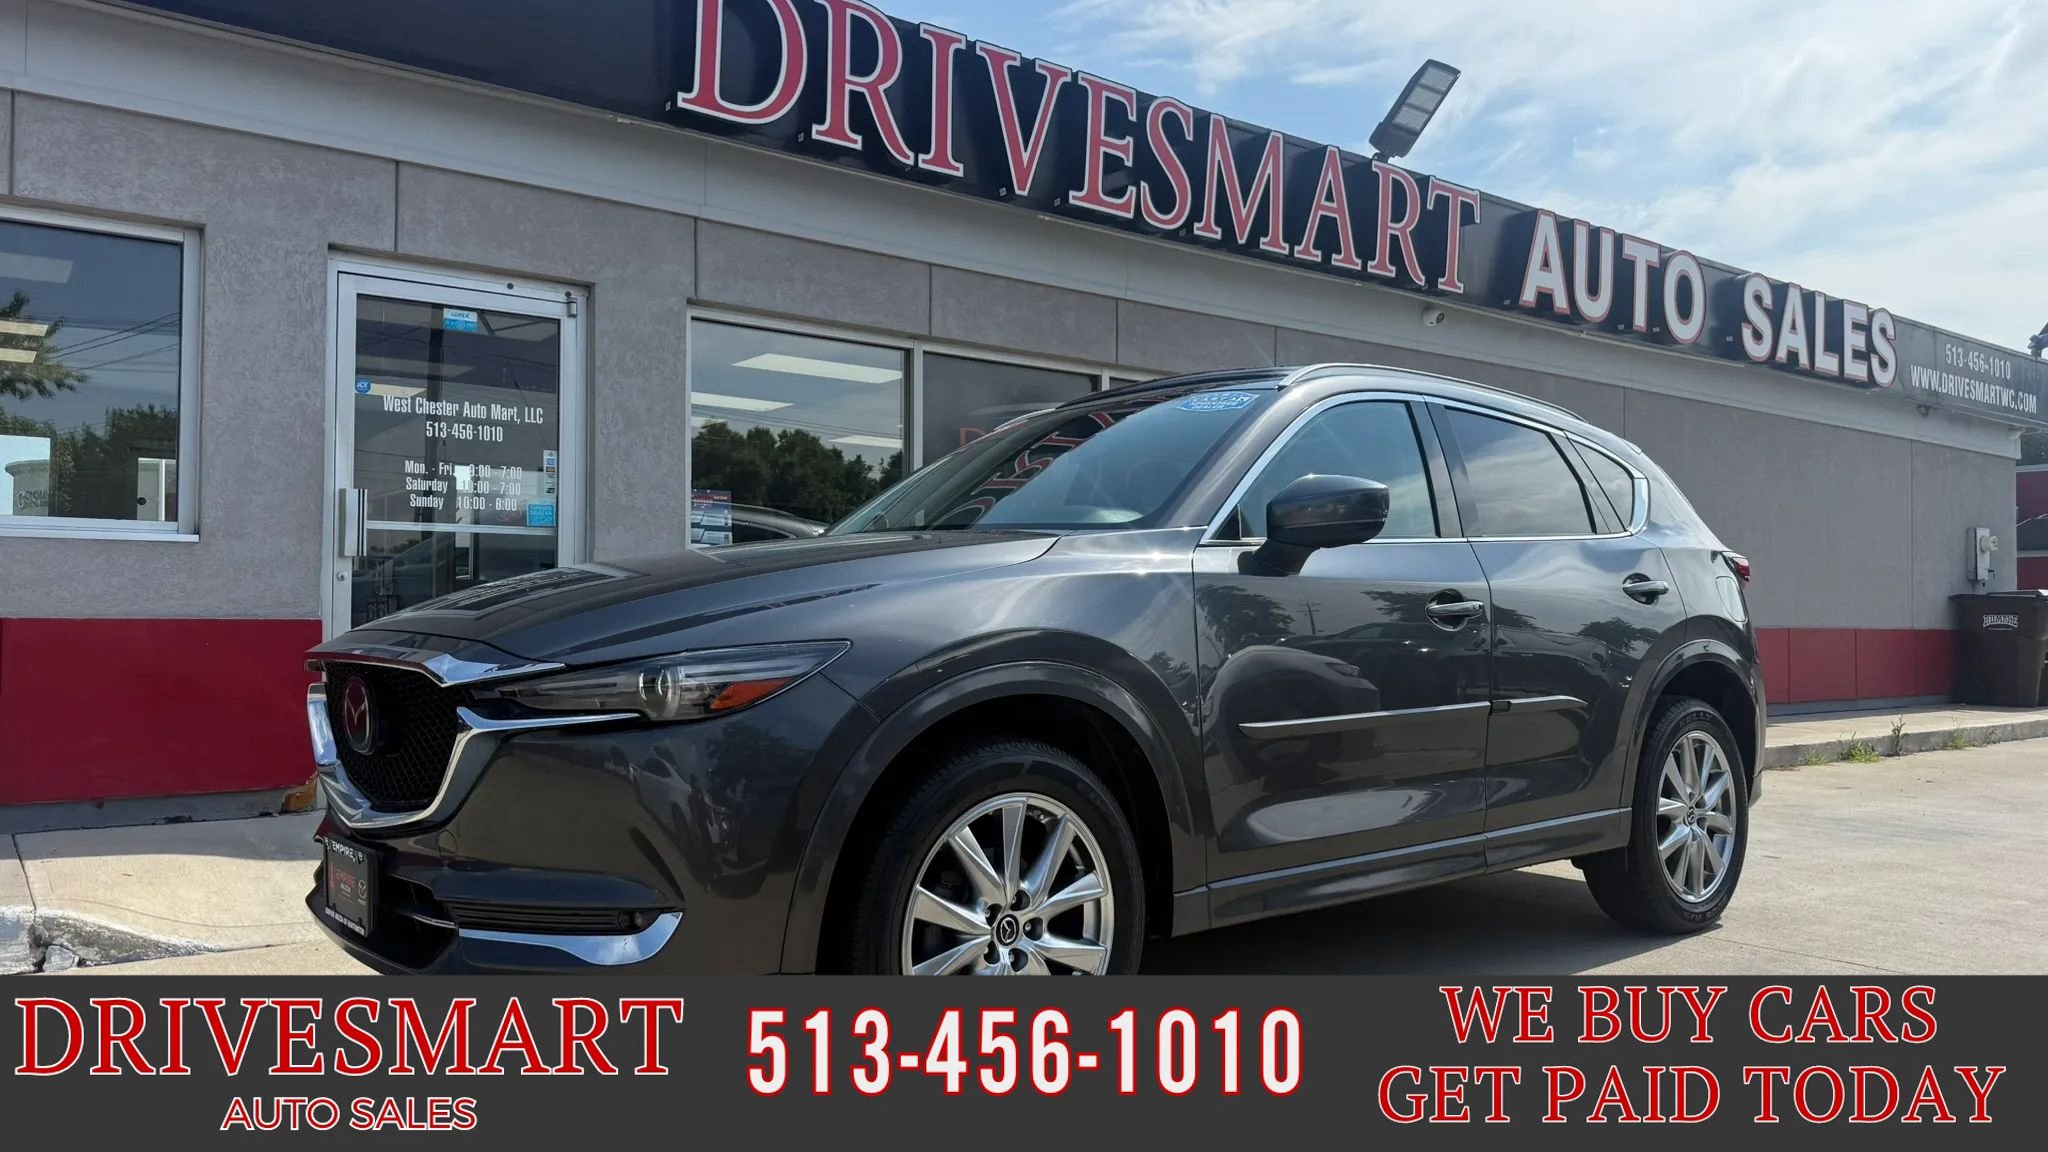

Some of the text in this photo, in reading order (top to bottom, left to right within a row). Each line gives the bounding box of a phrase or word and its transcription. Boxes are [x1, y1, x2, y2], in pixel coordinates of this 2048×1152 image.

[676, 0, 1898, 388] DRIVESMART AUTO SALES
[1945, 343, 2011, 380] 513-456-1010
[1910, 364, 2037, 414] WWW.DRIVESMARTWC.COM
[383, 395, 544, 424] West Chester Auto Mart, LLC
[426, 421, 504, 442] 513-456-1010
[404, 460, 429, 475] Mon.
[438, 462, 456, 477] Fri.
[500, 465, 523, 480] 7:00
[405, 477, 449, 494] Saturday
[500, 481, 521, 495] 7:00
[409, 493, 444, 510] Sunday
[458, 496, 486, 510] 10:00
